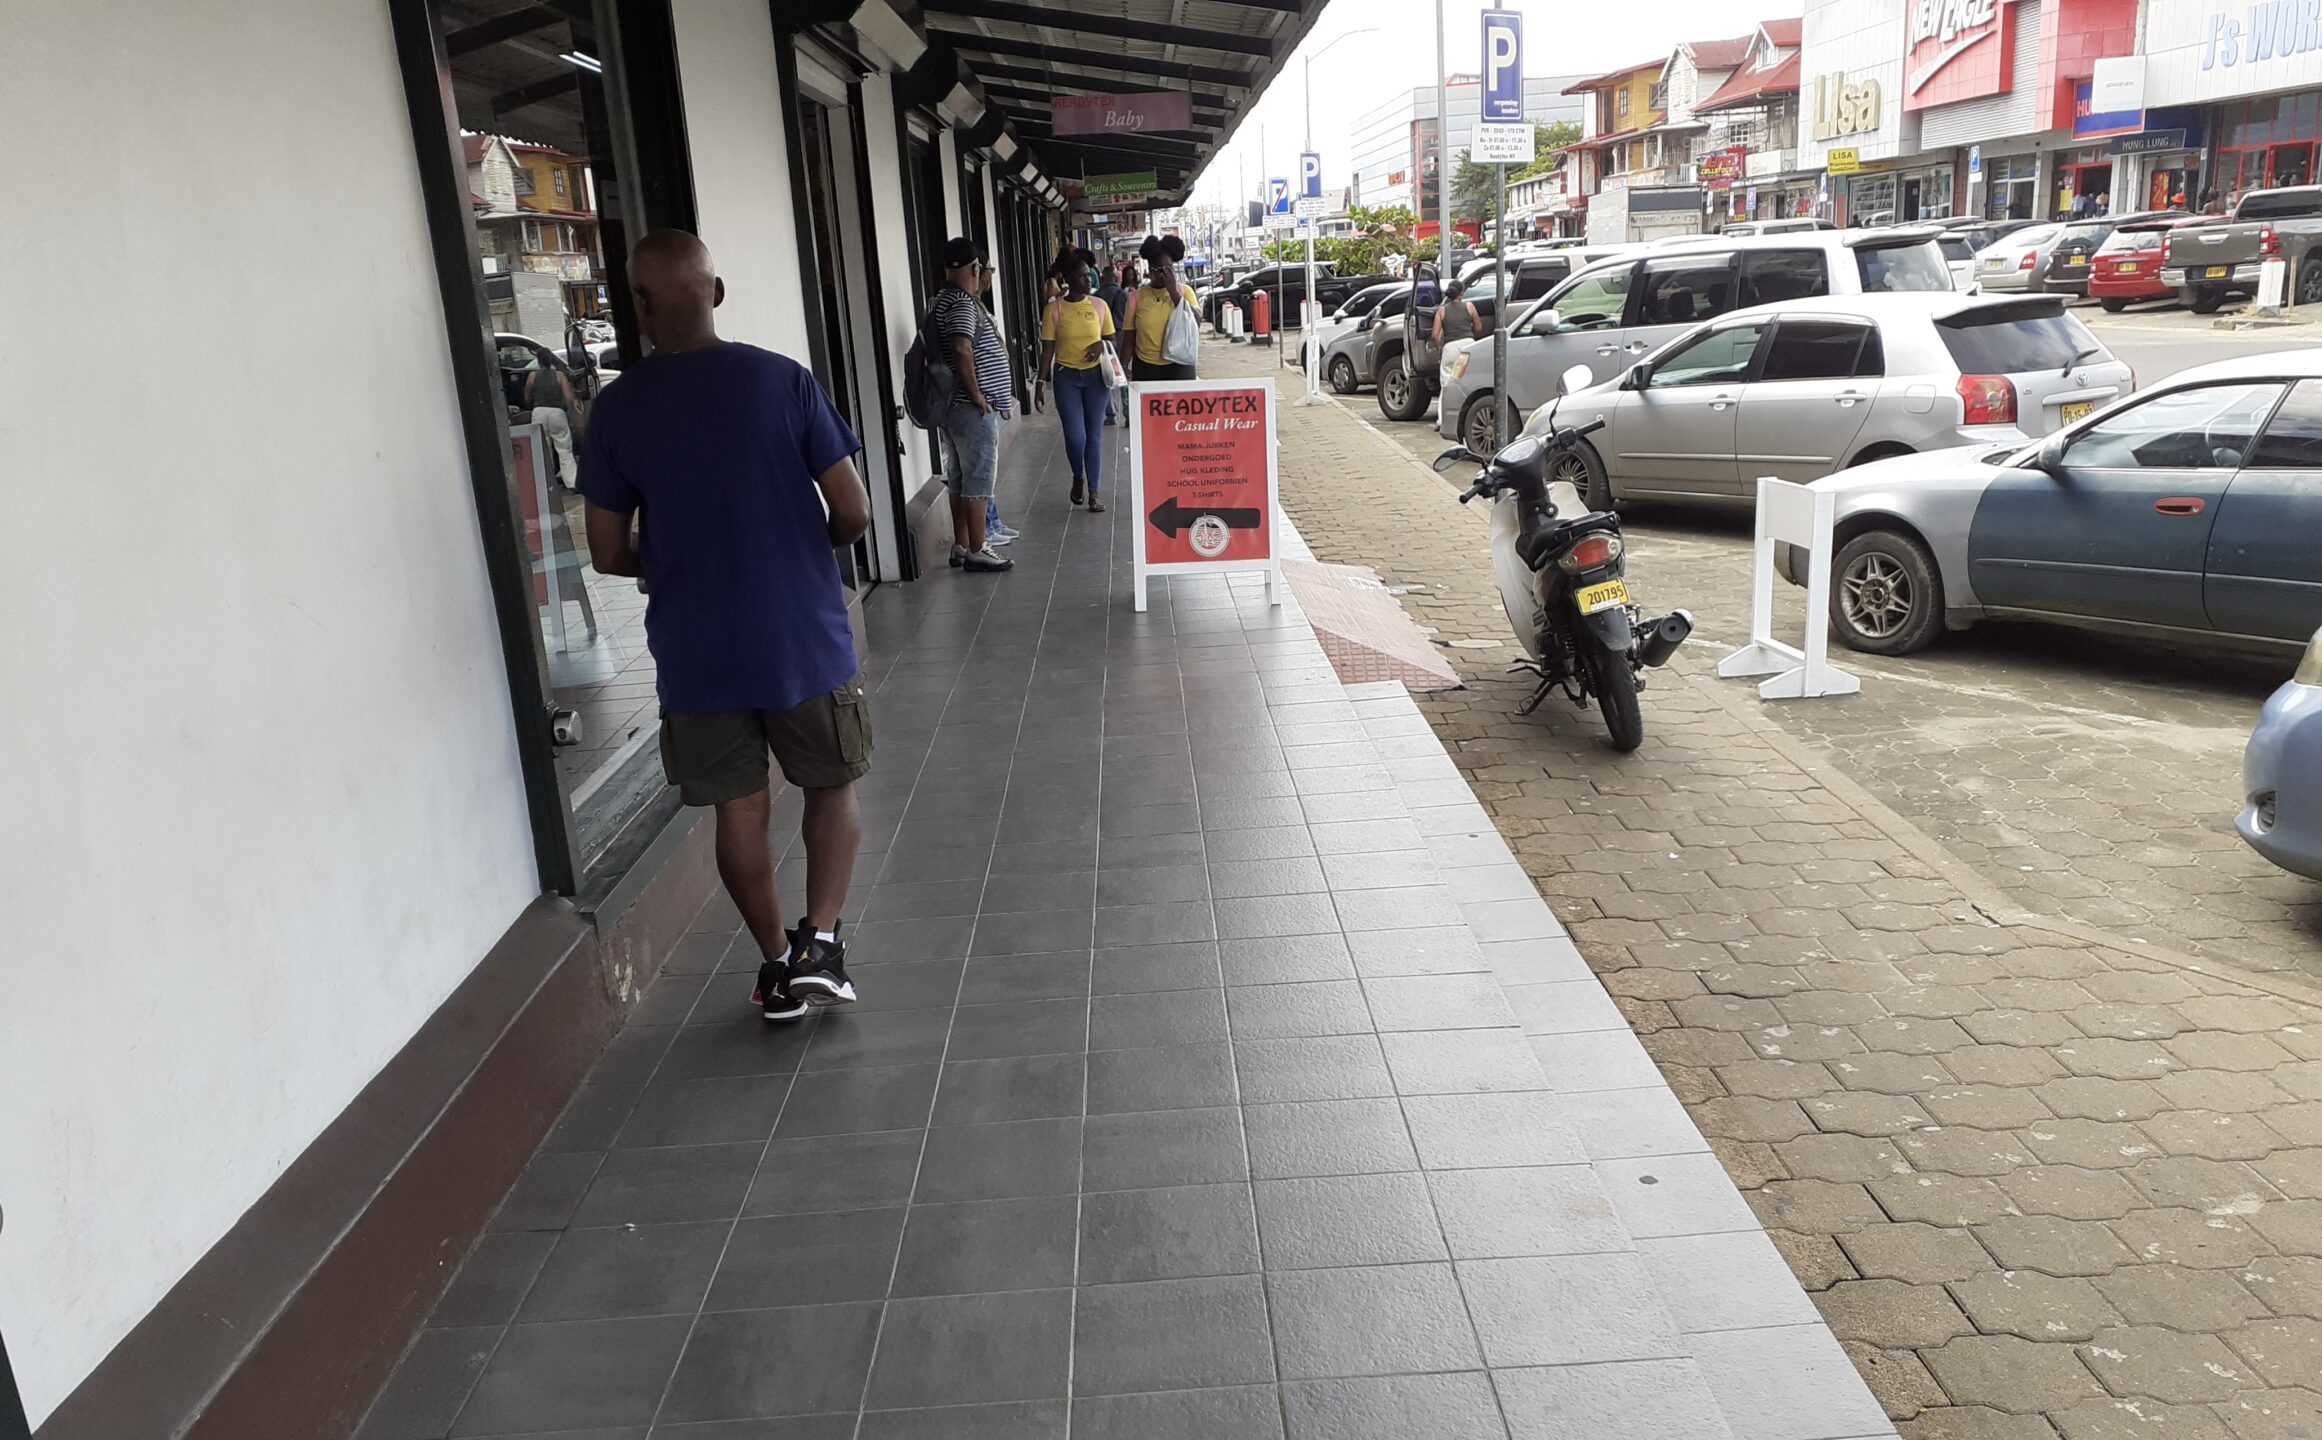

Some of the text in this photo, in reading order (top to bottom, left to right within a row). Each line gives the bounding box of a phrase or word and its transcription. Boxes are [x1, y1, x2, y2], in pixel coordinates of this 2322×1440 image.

[1909, 0, 1944, 55] NEW
[2245, 0, 2322, 63] WOR
[1488, 26, 1517, 92] P
[2077, 99, 2094, 118] HU
[1104, 110, 1144, 130] Baby
[2122, 137, 2169, 150] HUNG LUNG
[1833, 151, 1853, 160] LISA
[1302, 157, 1319, 195] P
[1085, 183, 1109, 194] Crafts
[1149, 396, 1257, 416] READYTEX
[1174, 418, 1259, 432] Casual Wear
[1181, 454, 1232, 462] ONDERGOED
[1201, 478, 1248, 486] UNIFORMEN
[1587, 585, 1624, 605] 201795
